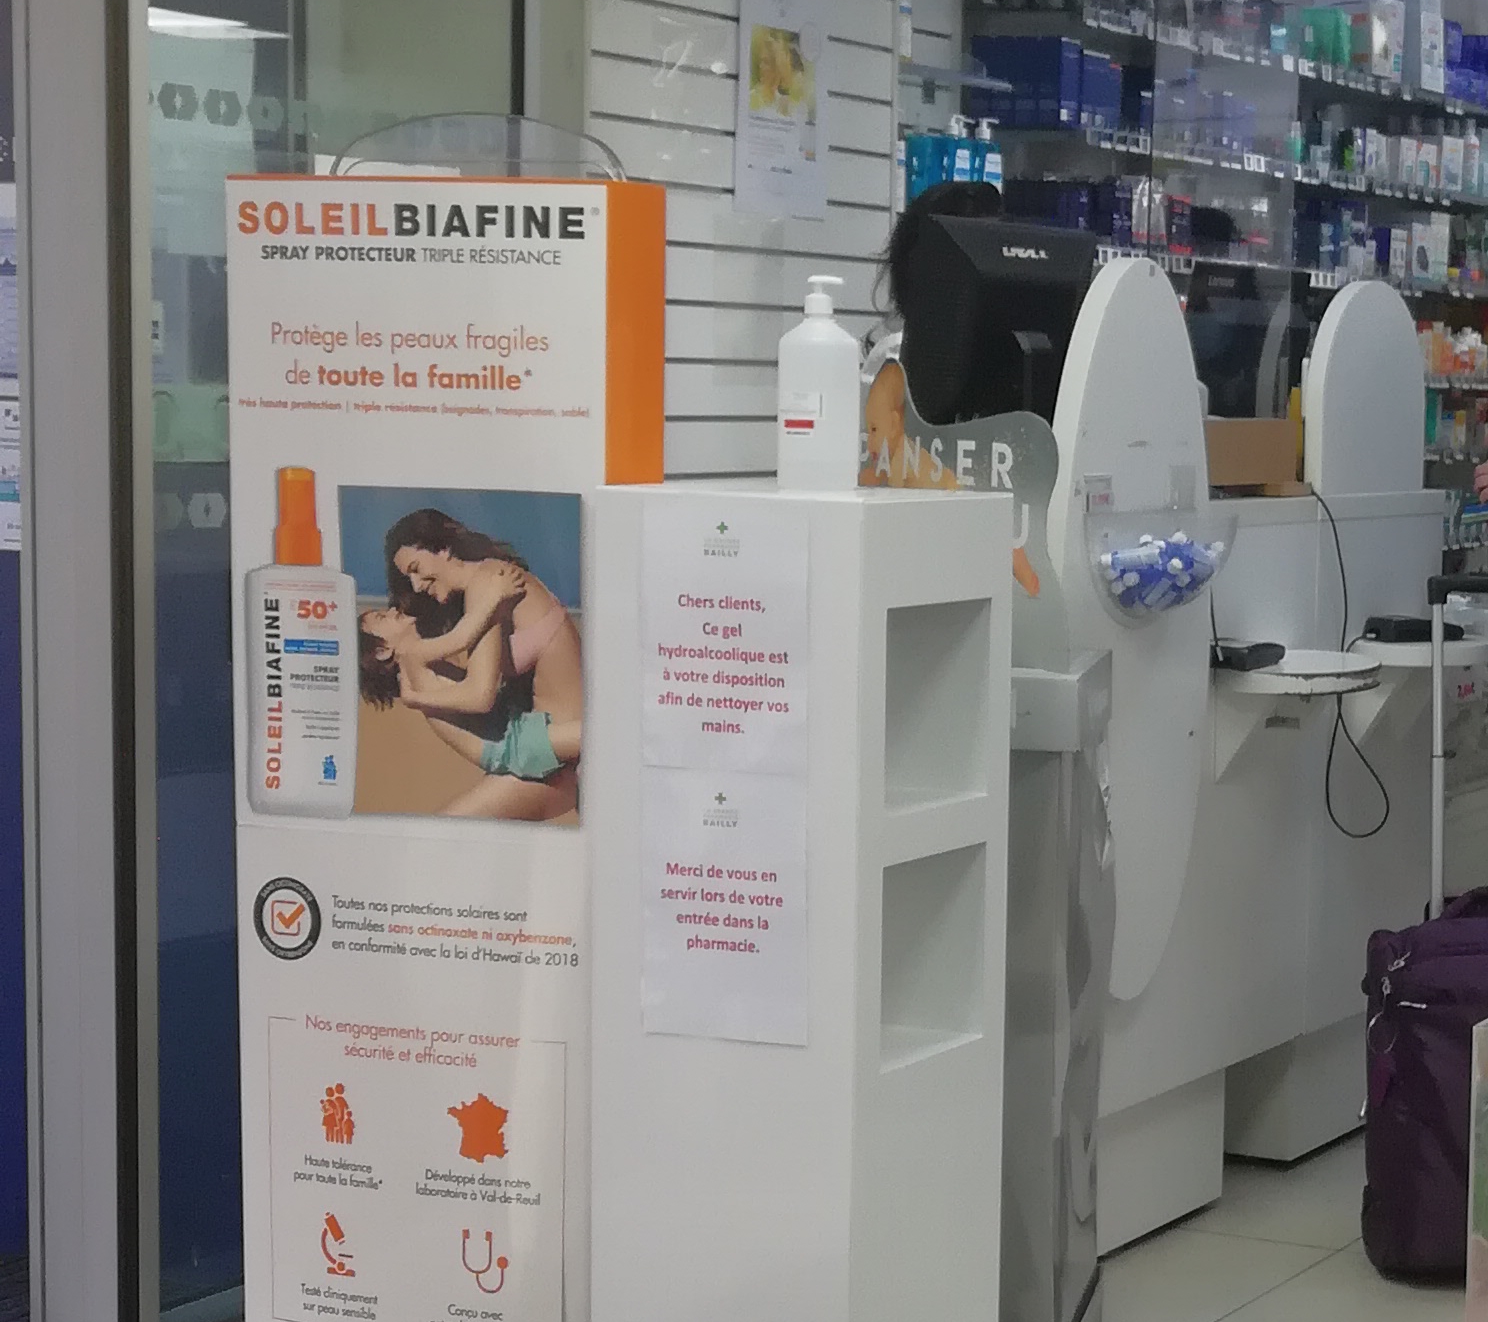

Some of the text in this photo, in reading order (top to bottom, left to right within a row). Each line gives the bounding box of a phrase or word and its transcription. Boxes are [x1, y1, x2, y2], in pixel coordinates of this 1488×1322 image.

[261, 244, 562, 266] SPRAY PROTECTEUR TRIPLE RÉSISTANCE
[271, 321, 550, 357] Protège les peaux fragiles
[285, 360, 311, 385] de
[317, 365, 384, 387] toute
[393, 363, 418, 388] la
[678, 594, 766, 613] Chers clients,
[702, 622, 742, 639] Ce gel
[657, 643, 789, 664] hydroalcoolique est
[663, 667, 785, 688] à votre disposition
[658, 692, 789, 713] afin de nettoyer vos
[701, 720, 745, 734] mains.
[666, 862, 777, 883] Merci de vous en
[660, 887, 783, 908] servir lors de votre
[332, 895, 528, 922] Toutes nos protections solaires sont
[331, 916, 385, 933] formulées
[388, 924, 414, 935] sans
[676, 911, 769, 930] entrée dans la
[331, 940, 346, 951] en
[348, 939, 407, 956] conformité
[410, 946, 437, 958] avec
[440, 943, 451, 959] la
[454, 944, 468, 961] loi
[524, 950, 541, 965] de
[545, 952, 579, 968] 2018
[686, 935, 760, 954] pharmacie.
[305, 1014, 520, 1049] Nos engagements pour assurer
[344, 1043, 477, 1068] sécurité et efficacité
[304, 1154, 373, 1174] Haute tolérance
[293, 1171, 314, 1184] pour
[315, 1171, 336, 1185] toute
[338, 1173, 348, 1186] la
[424, 1169, 531, 1190] Développé dans notre
[415, 1183, 541, 1207] laboratoire à Val-de-Reuil
[300, 1283, 322, 1298] Testé
[302, 1301, 376, 1320] sur peau sensible
[447, 1304, 503, 1322] Conçu avec
